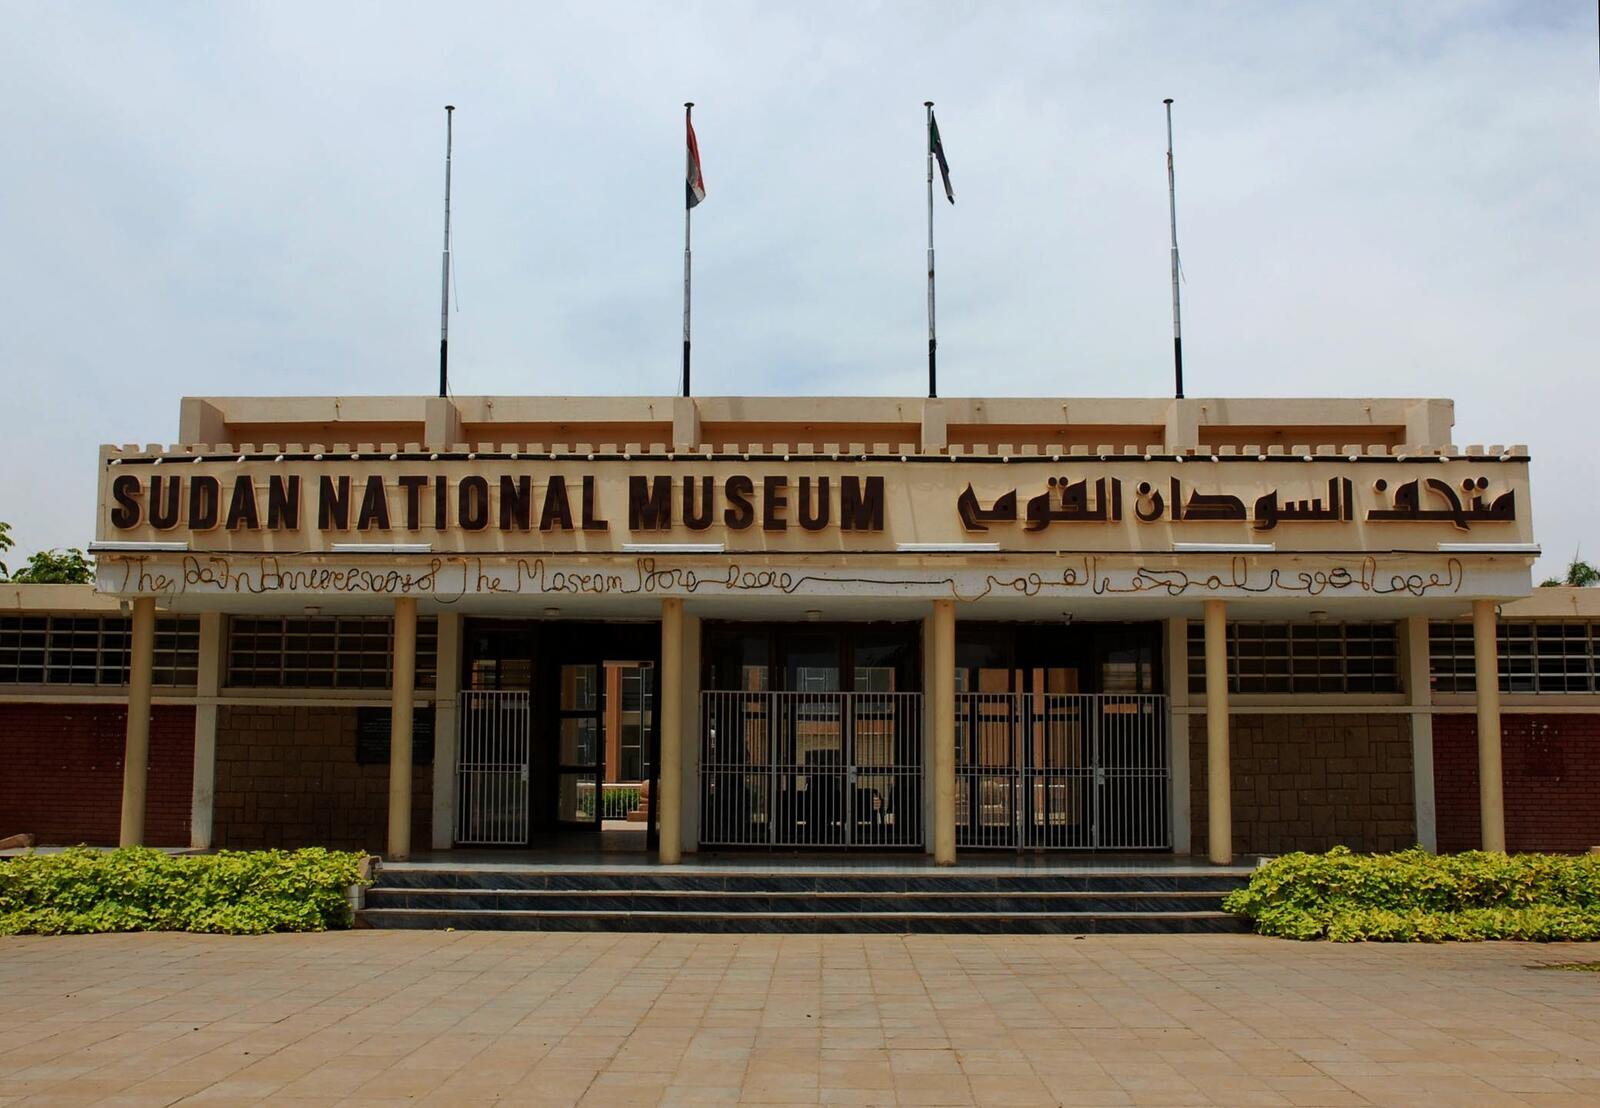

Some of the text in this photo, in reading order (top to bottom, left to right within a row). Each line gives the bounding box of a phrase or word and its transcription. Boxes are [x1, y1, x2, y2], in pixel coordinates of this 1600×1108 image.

[111, 475, 885, 532] SUDAN NATIONAL MUSEUM
[1135, 475, 1354, 533] السودان
[1366, 475, 1517, 532] متحف
